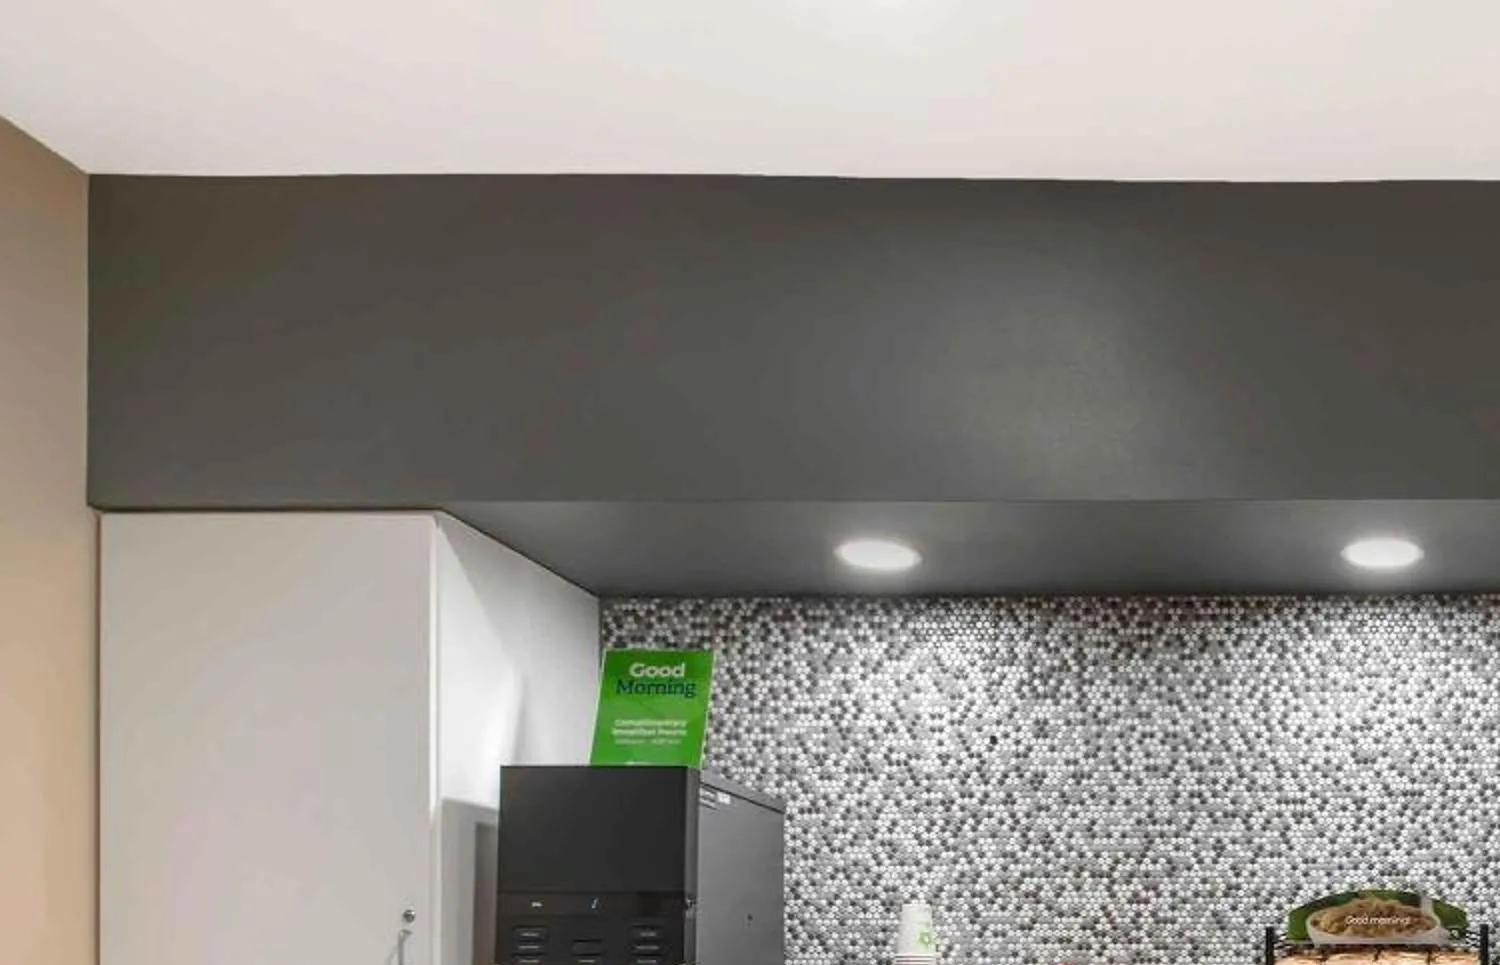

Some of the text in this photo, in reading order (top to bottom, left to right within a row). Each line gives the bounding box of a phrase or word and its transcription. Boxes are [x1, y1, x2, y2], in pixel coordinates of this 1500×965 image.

[629, 662, 686, 677] Good
[616, 680, 696, 698] Morning
[1345, 914, 1368, 925] Good
